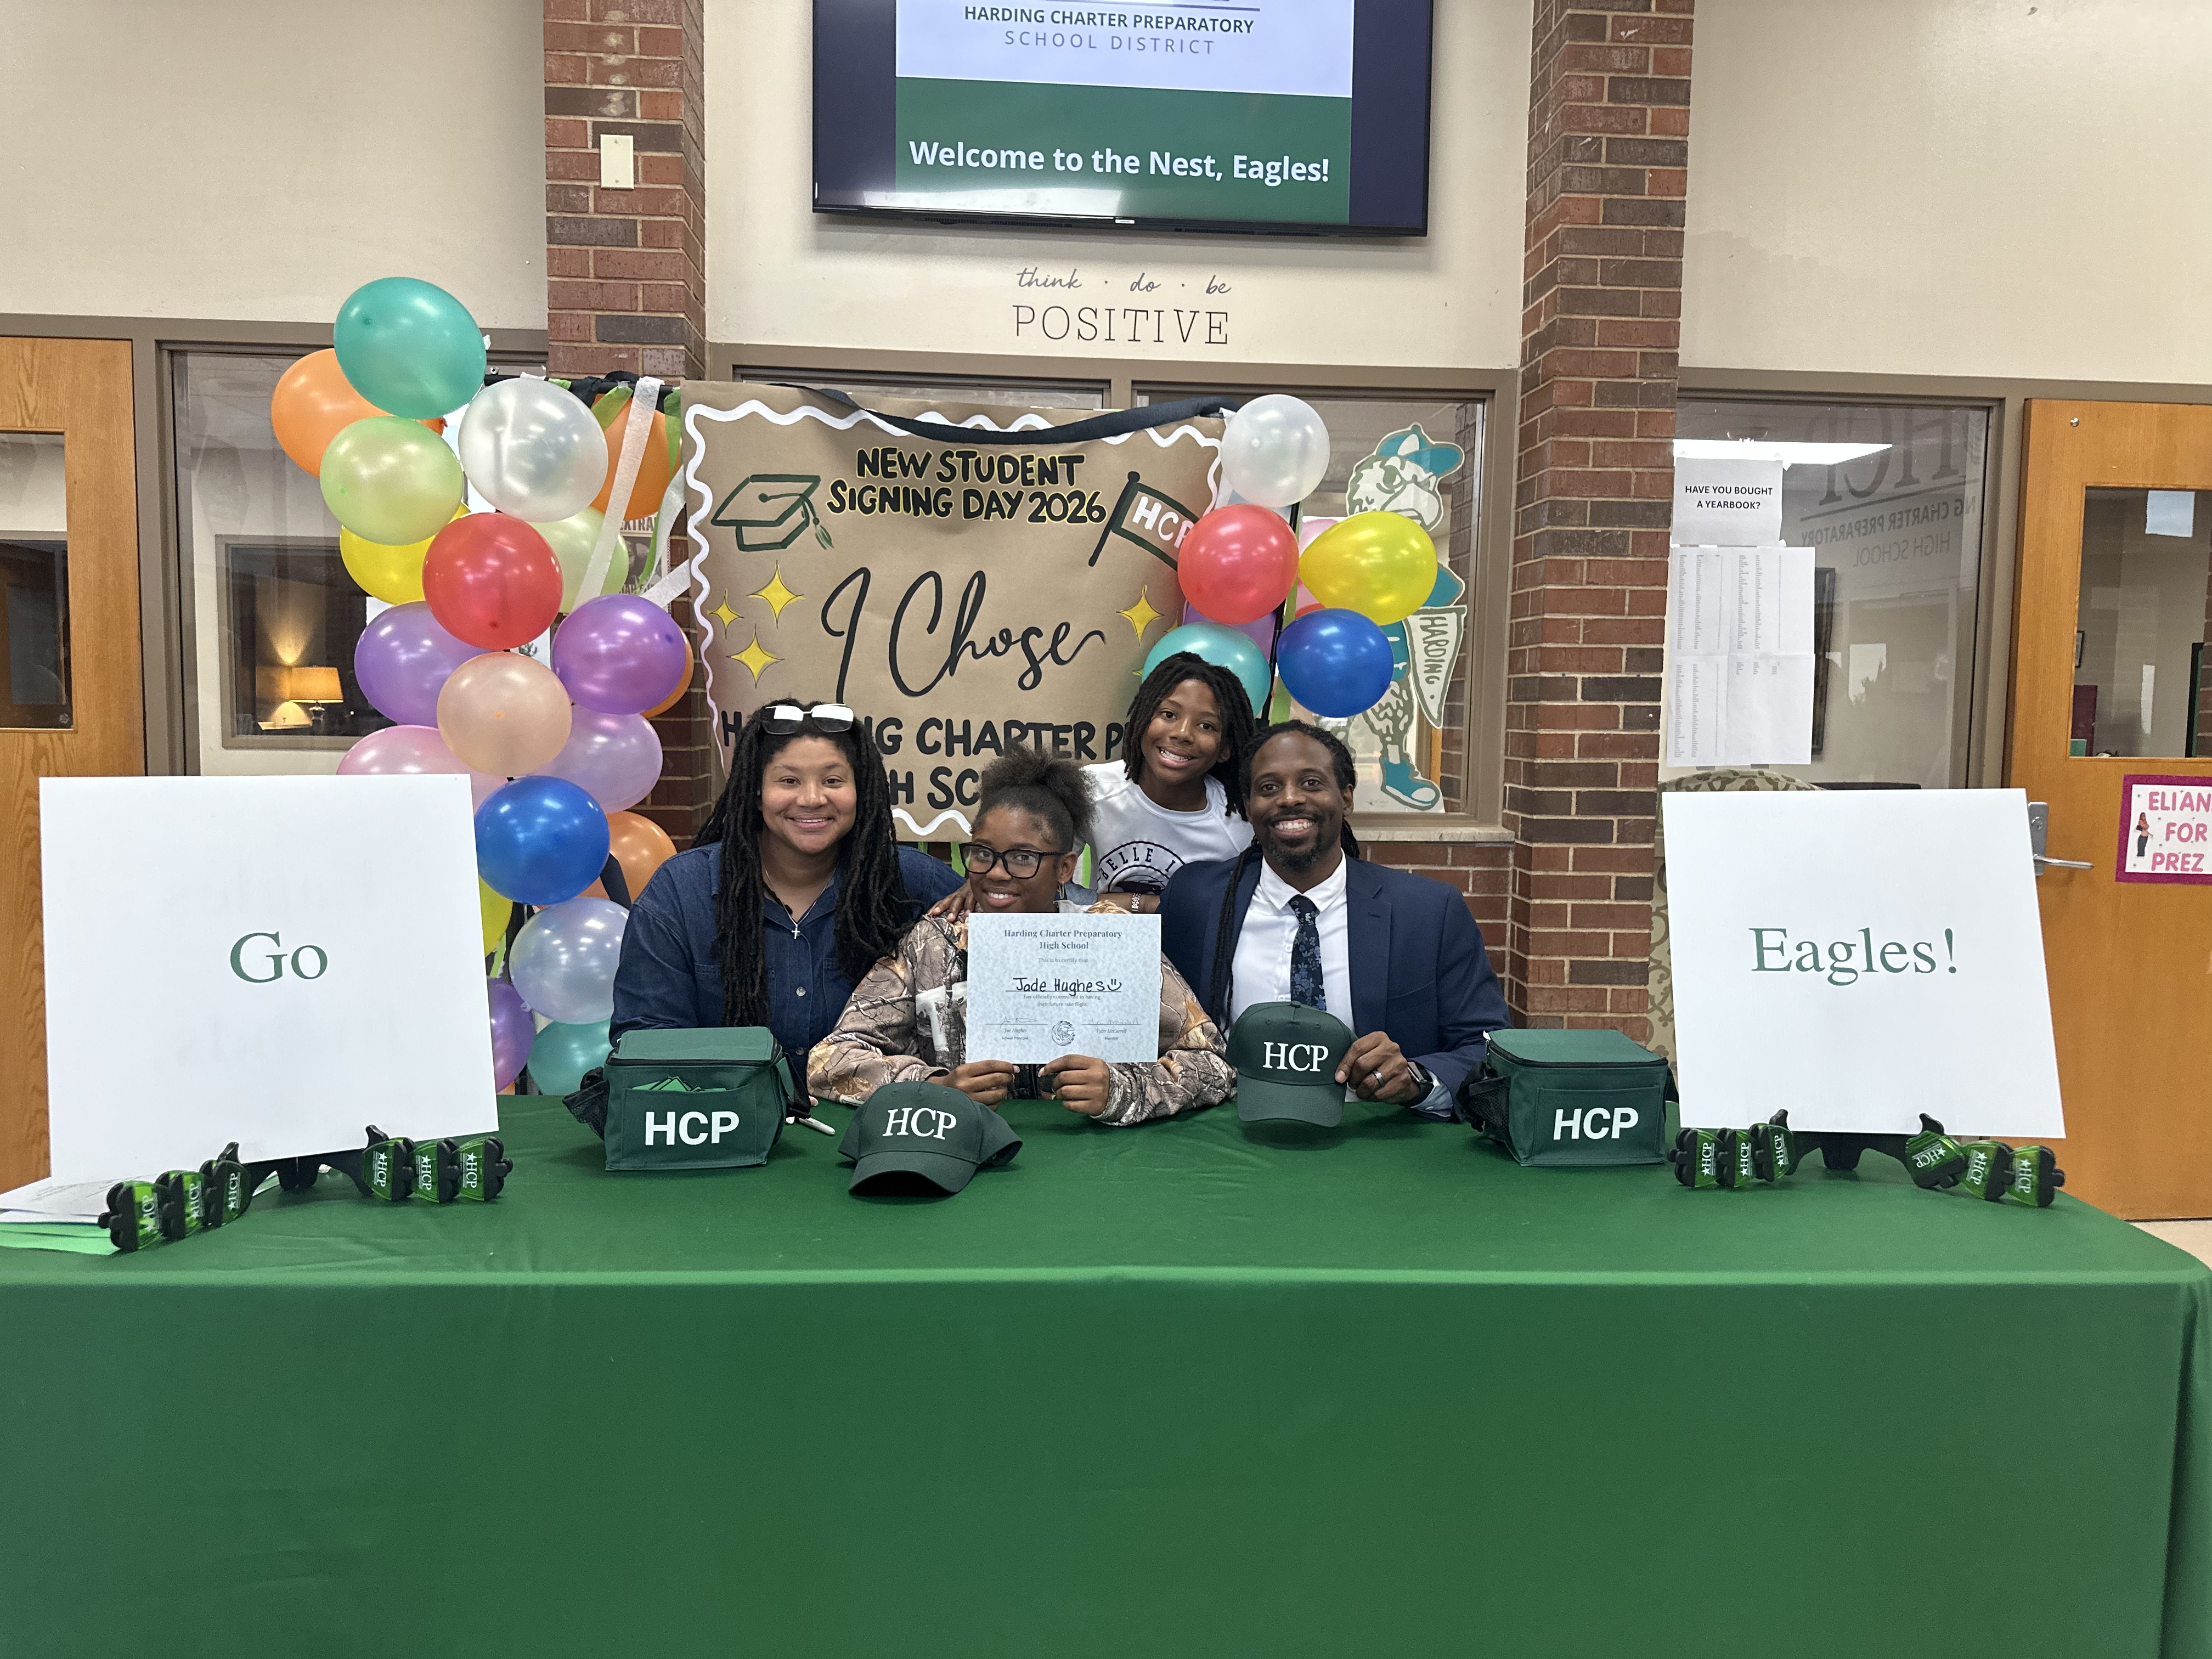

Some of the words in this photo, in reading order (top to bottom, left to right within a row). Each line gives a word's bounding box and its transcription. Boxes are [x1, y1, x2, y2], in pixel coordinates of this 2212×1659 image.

[964, 6, 1045, 23] HARDING
[1050, 10, 1128, 28] CHARTER
[1133, 14, 1254, 33] PREPARATORY
[1005, 31, 1097, 49] SCHOOL
[1111, 36, 1215, 54] DISTRICT
[909, 140, 1045, 170] Welcome
[1053, 149, 1083, 172] to
[1092, 149, 1140, 174] the
[1150, 151, 1223, 181] Nest,
[1233, 155, 1330, 187] Eagles!
[1017, 267, 1082, 289] think
[1130, 273, 1162, 292] do
[1205, 274, 1232, 295] be
[1012, 304, 1228, 345] POSITIVE
[857, 447, 933, 479] NEW
[935, 449, 1086, 487] STUDENT
[826, 478, 953, 519] SIGNING
[961, 488, 1025, 522] DAY
[1027, 490, 1108, 525] 2026
[1685, 486, 1710, 494] HAVE
[1734, 487, 1773, 495] BOUGHT
[1705, 501, 1760, 509] YEARBOOK?
[821, 566, 871, 704] I
[888, 569, 1107, 697] Chose
[2148, 791, 2212, 812] ELIAN
[2165, 822, 2208, 843] FOR
[1099, 847, 1153, 880] BELLE
[2151, 852, 2204, 872] PREZ
[1004, 929, 1037, 938] Harding
[1074, 930, 1122, 939] Preparatory
[1040, 941, 1059, 951] High
[230, 931, 328, 983] Go
[1748, 927, 1957, 986] Eagles!
[1013, 978, 1047, 992] Jade
[1054, 978, 1105, 997] Hughes
[1262, 1041, 1329, 1072] HCP
[645, 1111, 740, 1146] HCP
[882, 1107, 957, 1140] HCP
[1553, 1107, 1639, 1140] HCP
[1702, 1142, 1712, 1167] HCP
[1740, 1142, 1749, 1167] HCP
[1774, 1135, 1785, 1160] HCP
[1912, 1148, 1940, 1168] HCP
[377, 1161, 387, 1187] HCP
[421, 1164, 432, 1190] HCP
[466, 1162, 477, 1188] HCP
[1970, 1159, 1987, 1185] HCP
[2019, 1168, 2032, 1193] HCP
[228, 1173, 239, 1203] HCP
